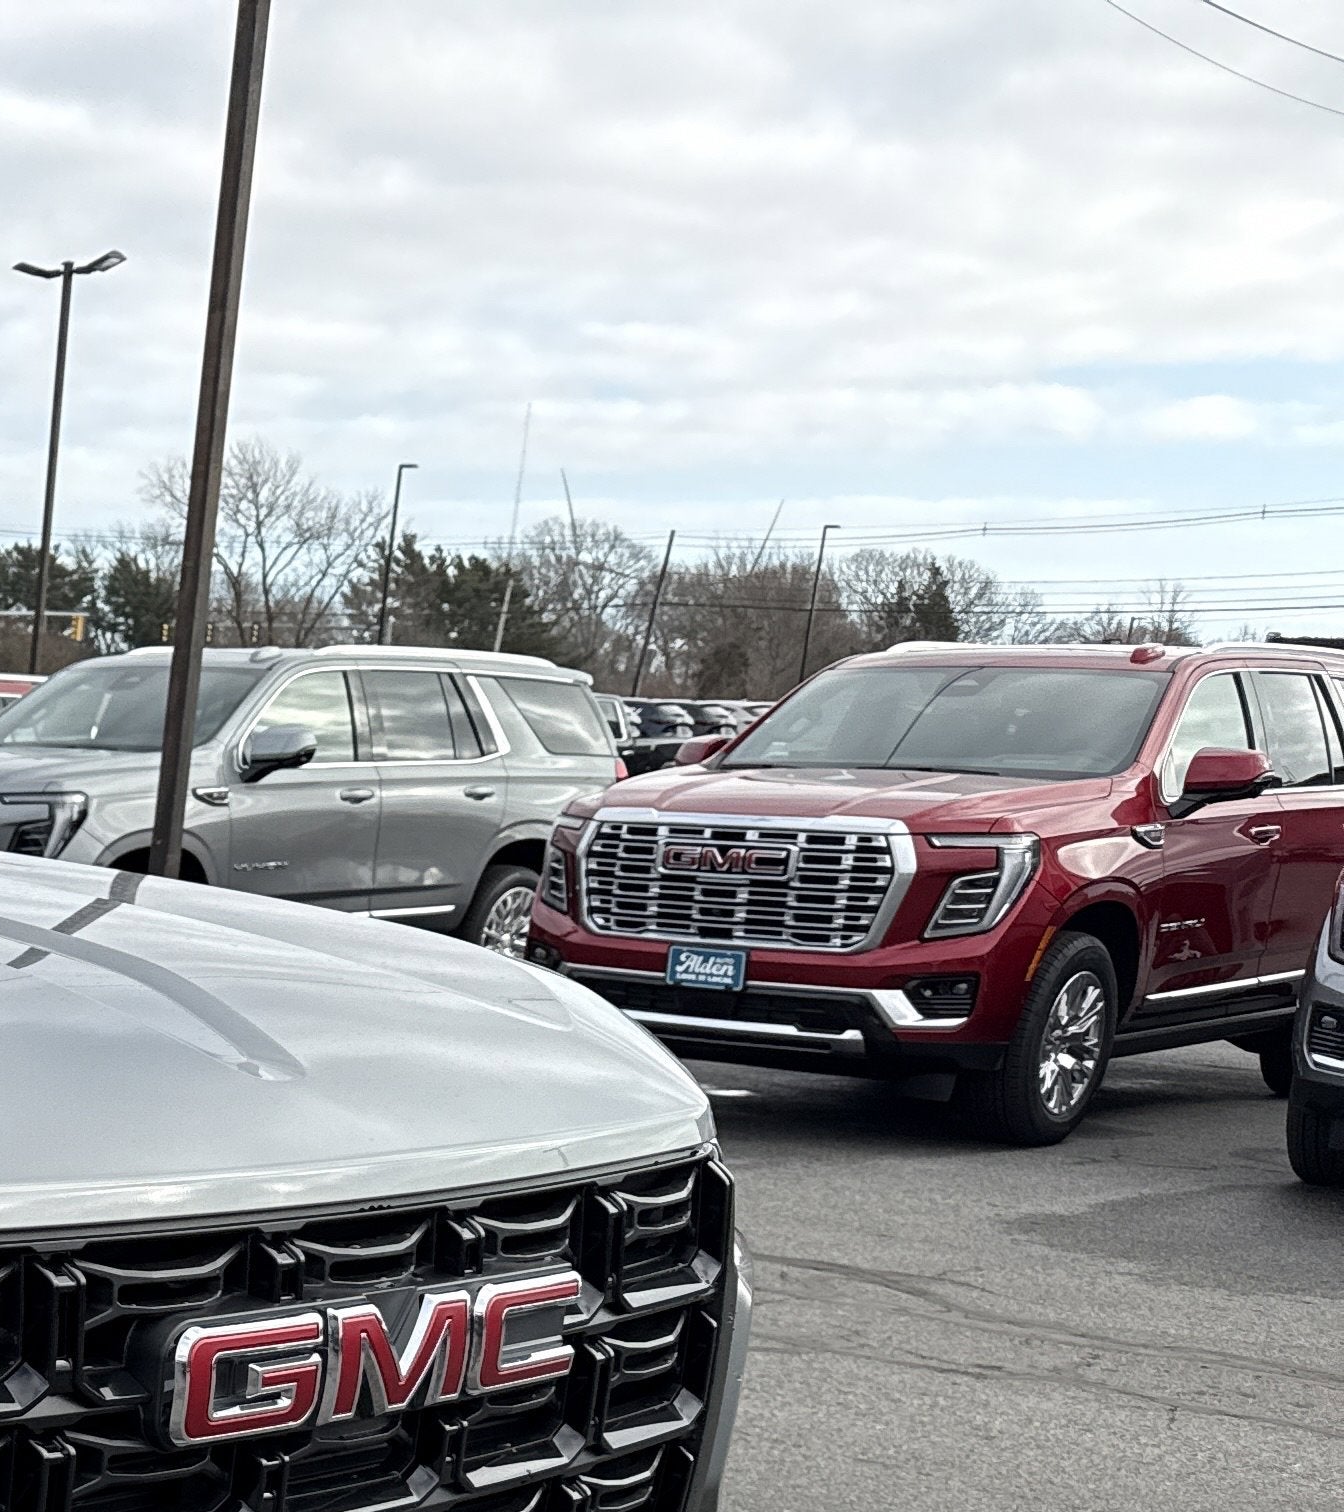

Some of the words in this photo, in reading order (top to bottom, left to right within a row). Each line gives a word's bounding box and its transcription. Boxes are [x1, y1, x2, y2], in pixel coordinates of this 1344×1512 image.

[663, 845, 787, 874] GMC
[675, 951, 736, 977] Alden
[170, 1270, 583, 1447] GMC
